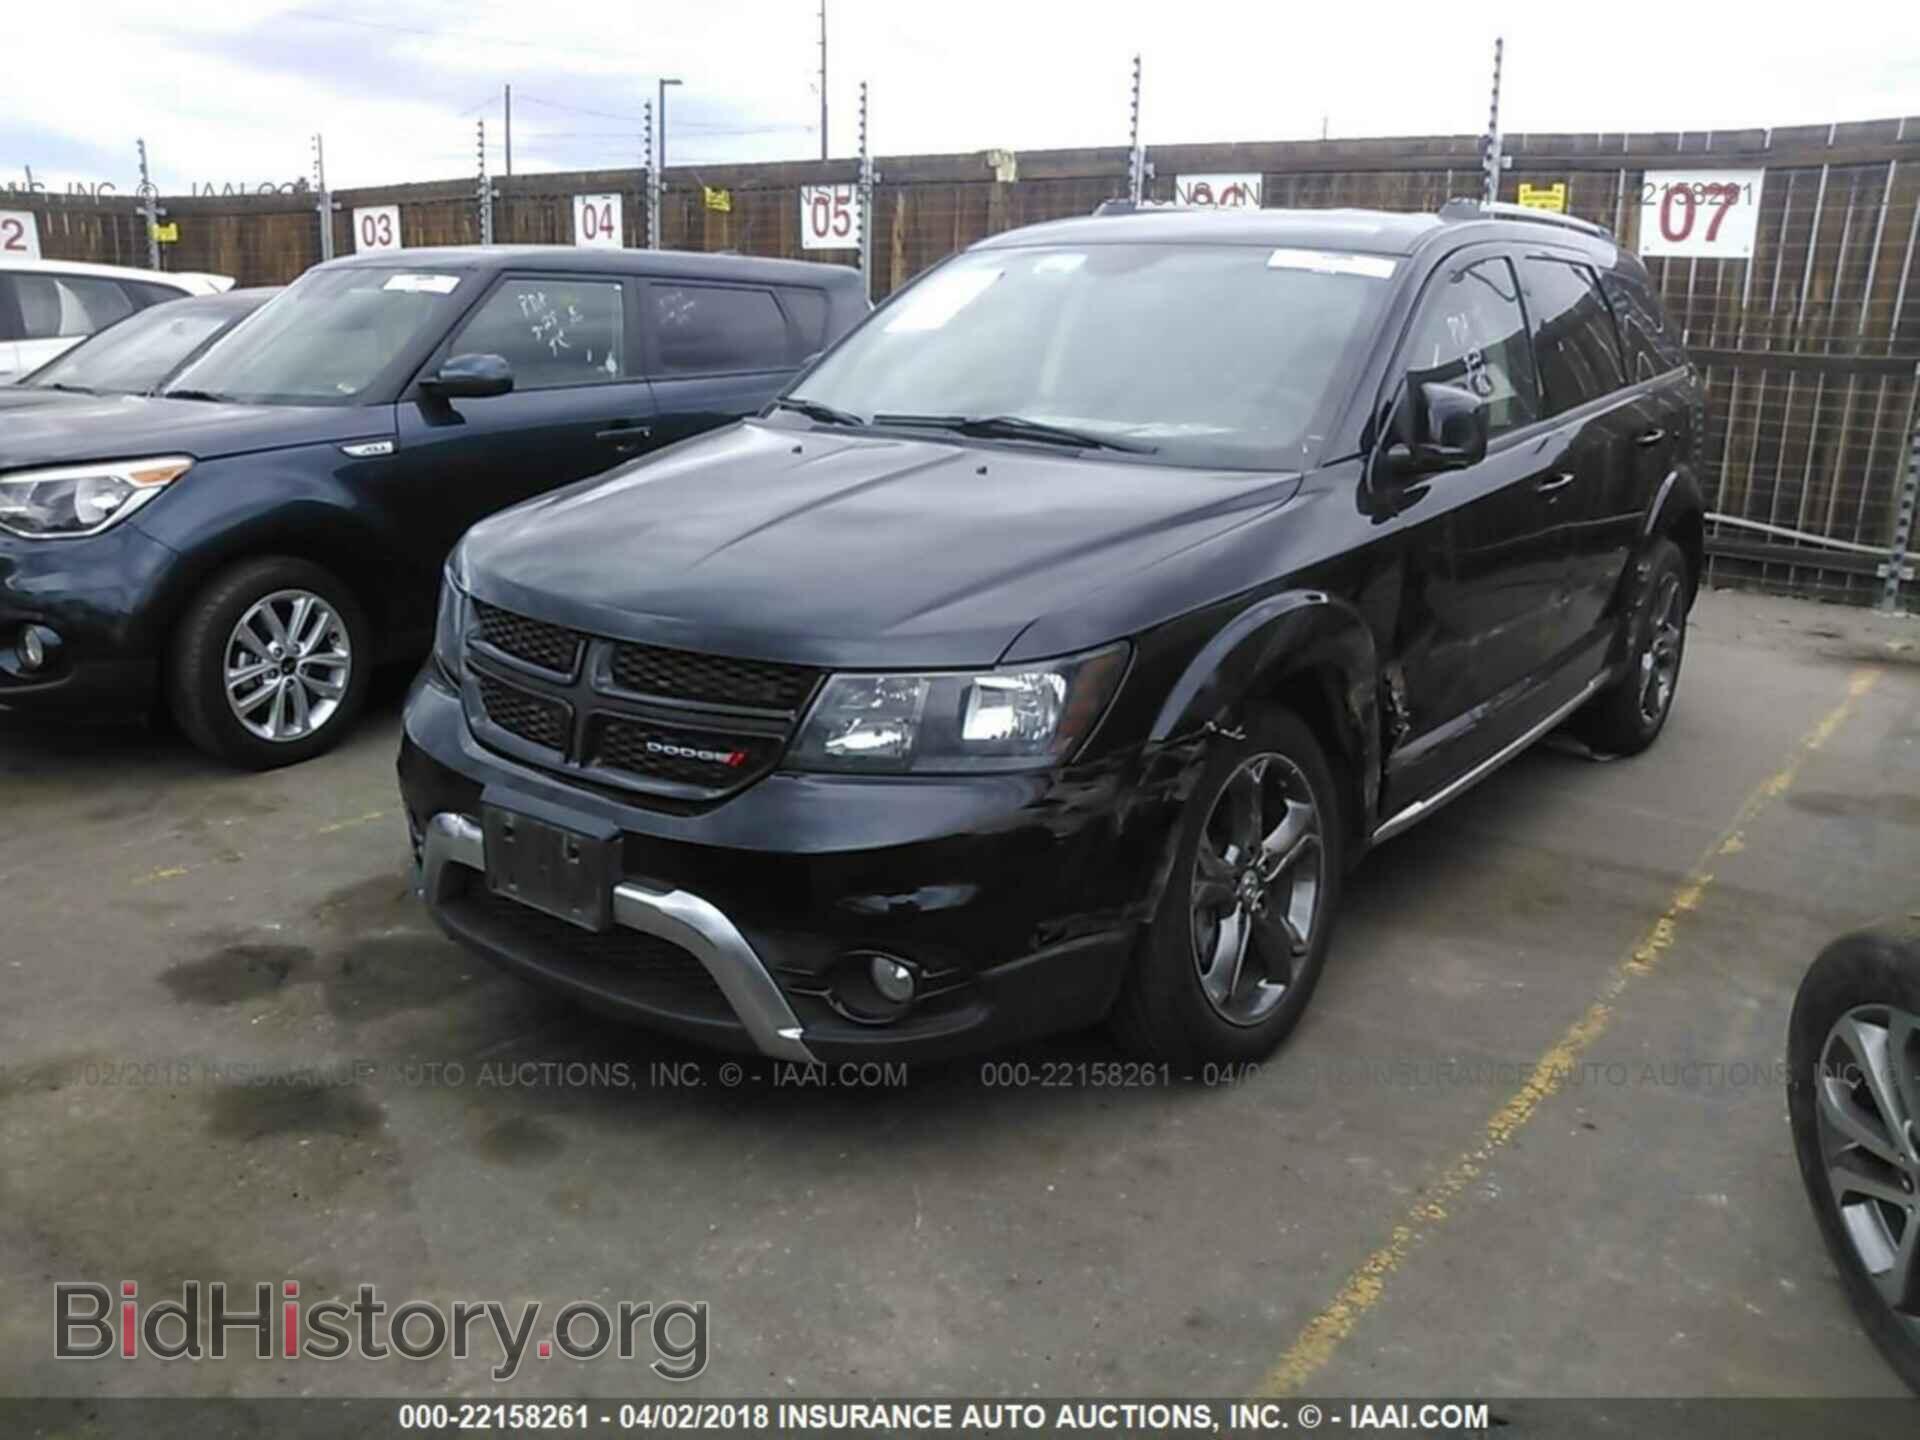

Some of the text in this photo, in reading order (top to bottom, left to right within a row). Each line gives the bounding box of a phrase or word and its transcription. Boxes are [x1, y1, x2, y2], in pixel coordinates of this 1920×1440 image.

[361, 213, 392, 247] 03
[583, 203, 614, 240] 04
[812, 196, 851, 238] 05
[1659, 184, 1741, 242] 07
[646, 742, 731, 762] DODGE
